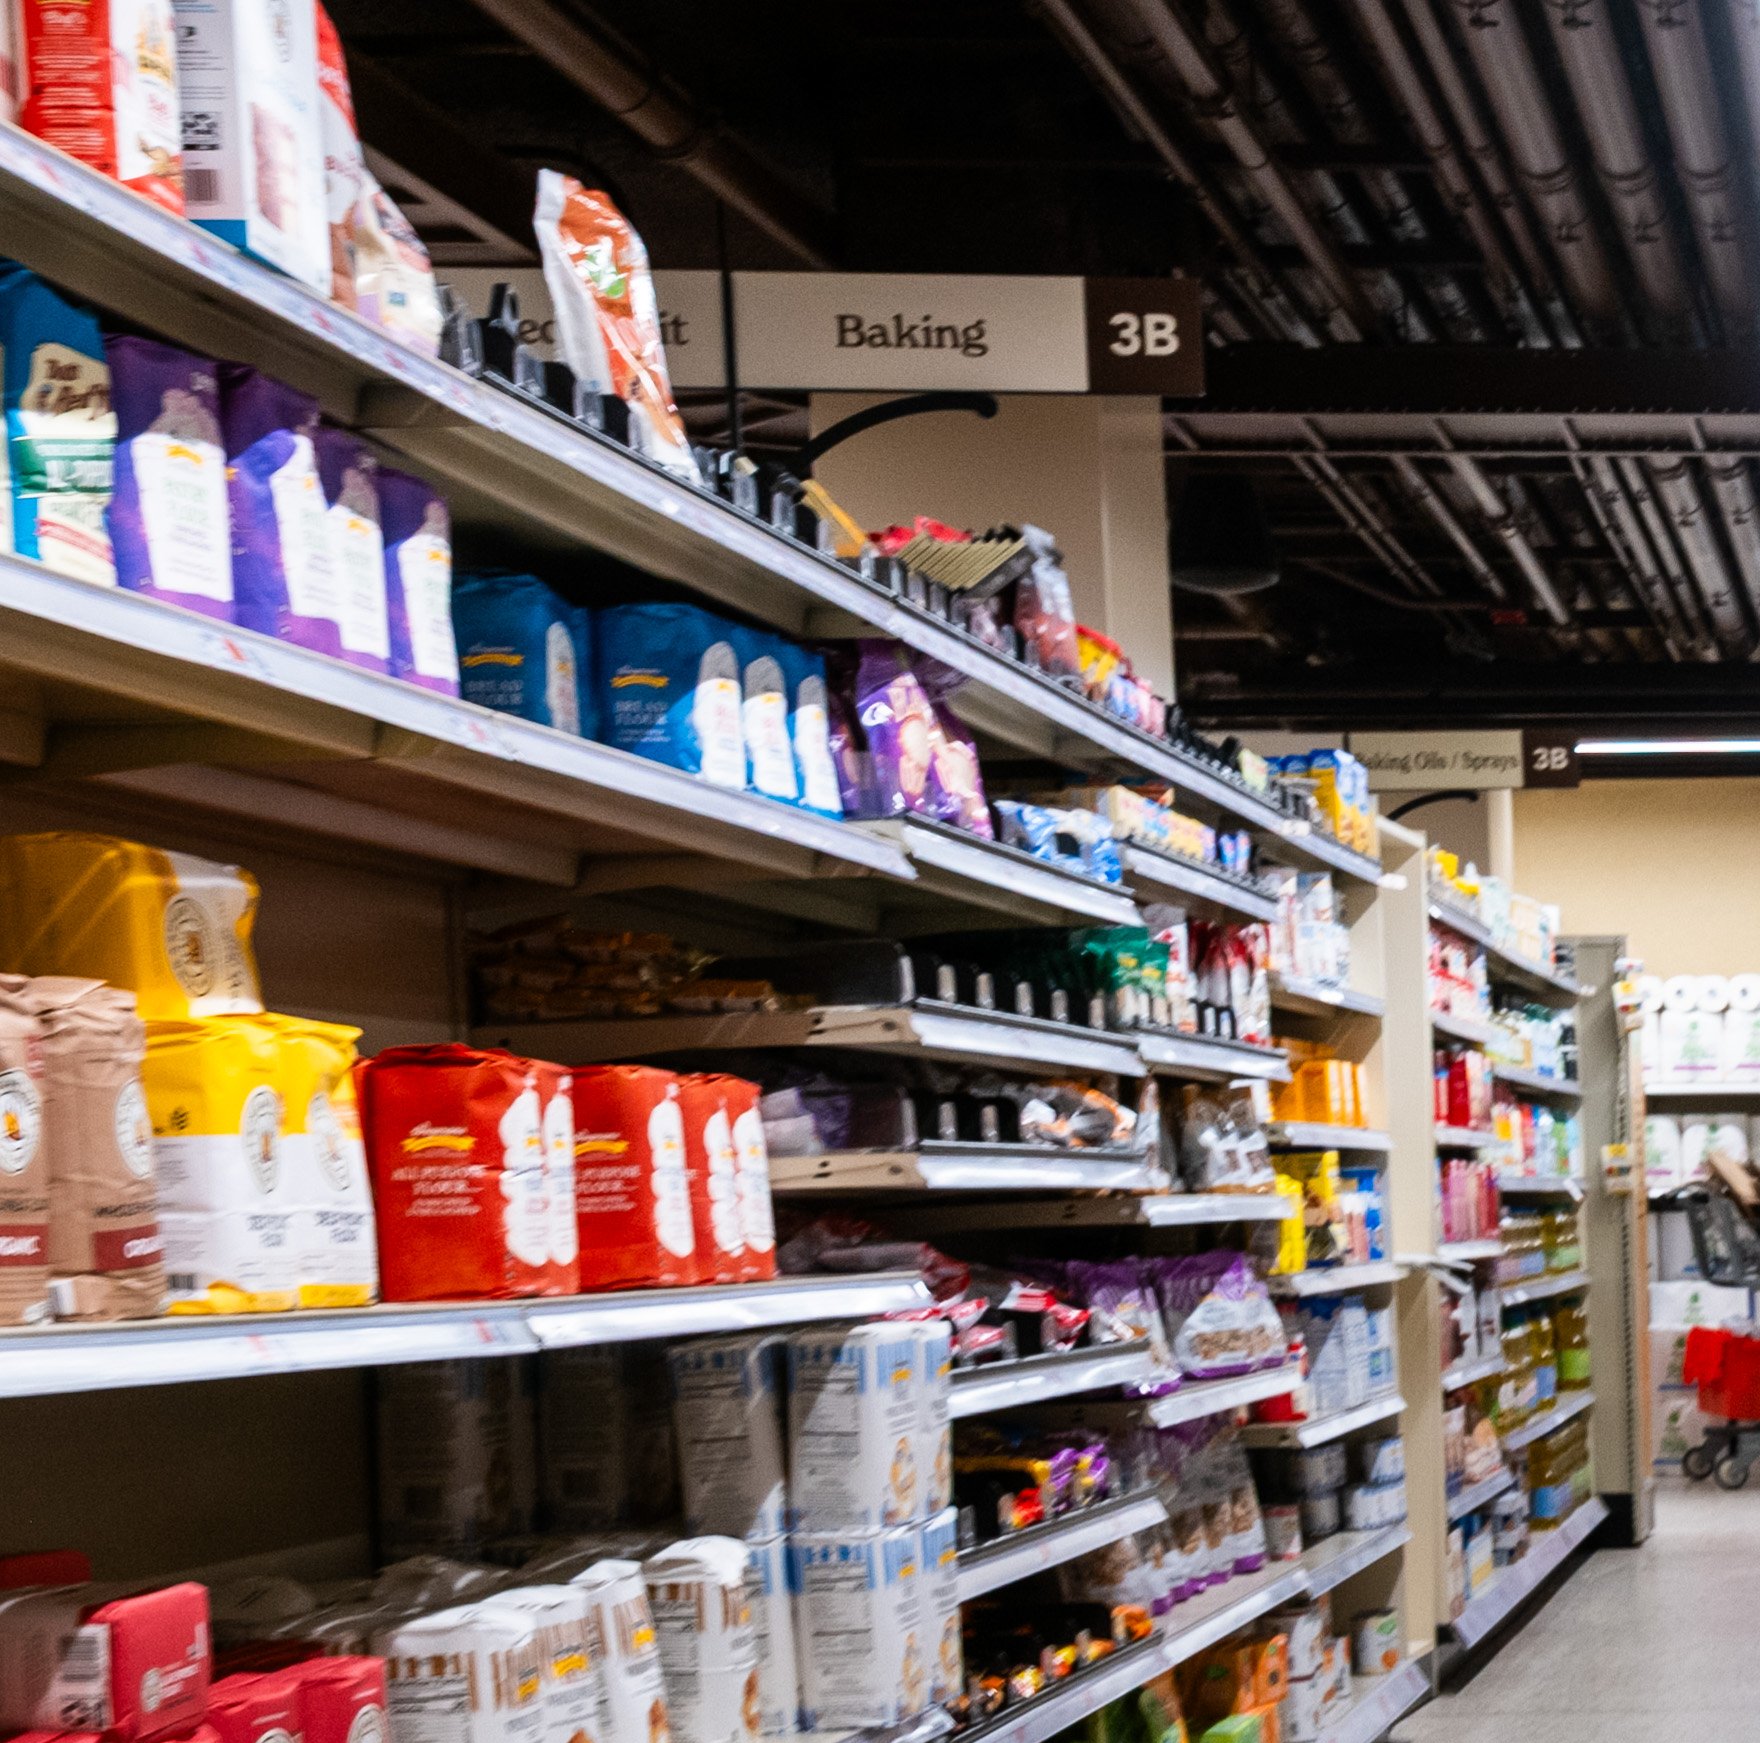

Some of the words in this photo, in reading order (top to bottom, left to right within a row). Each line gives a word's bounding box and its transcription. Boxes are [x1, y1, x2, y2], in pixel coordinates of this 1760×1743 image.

[835, 313, 989, 358] Baking
[1107, 311, 1180, 358] 3B
[1359, 751, 1411, 774] aking
[1461, 751, 1518, 773] Sprays
[1532, 747, 1570, 771] 3B
